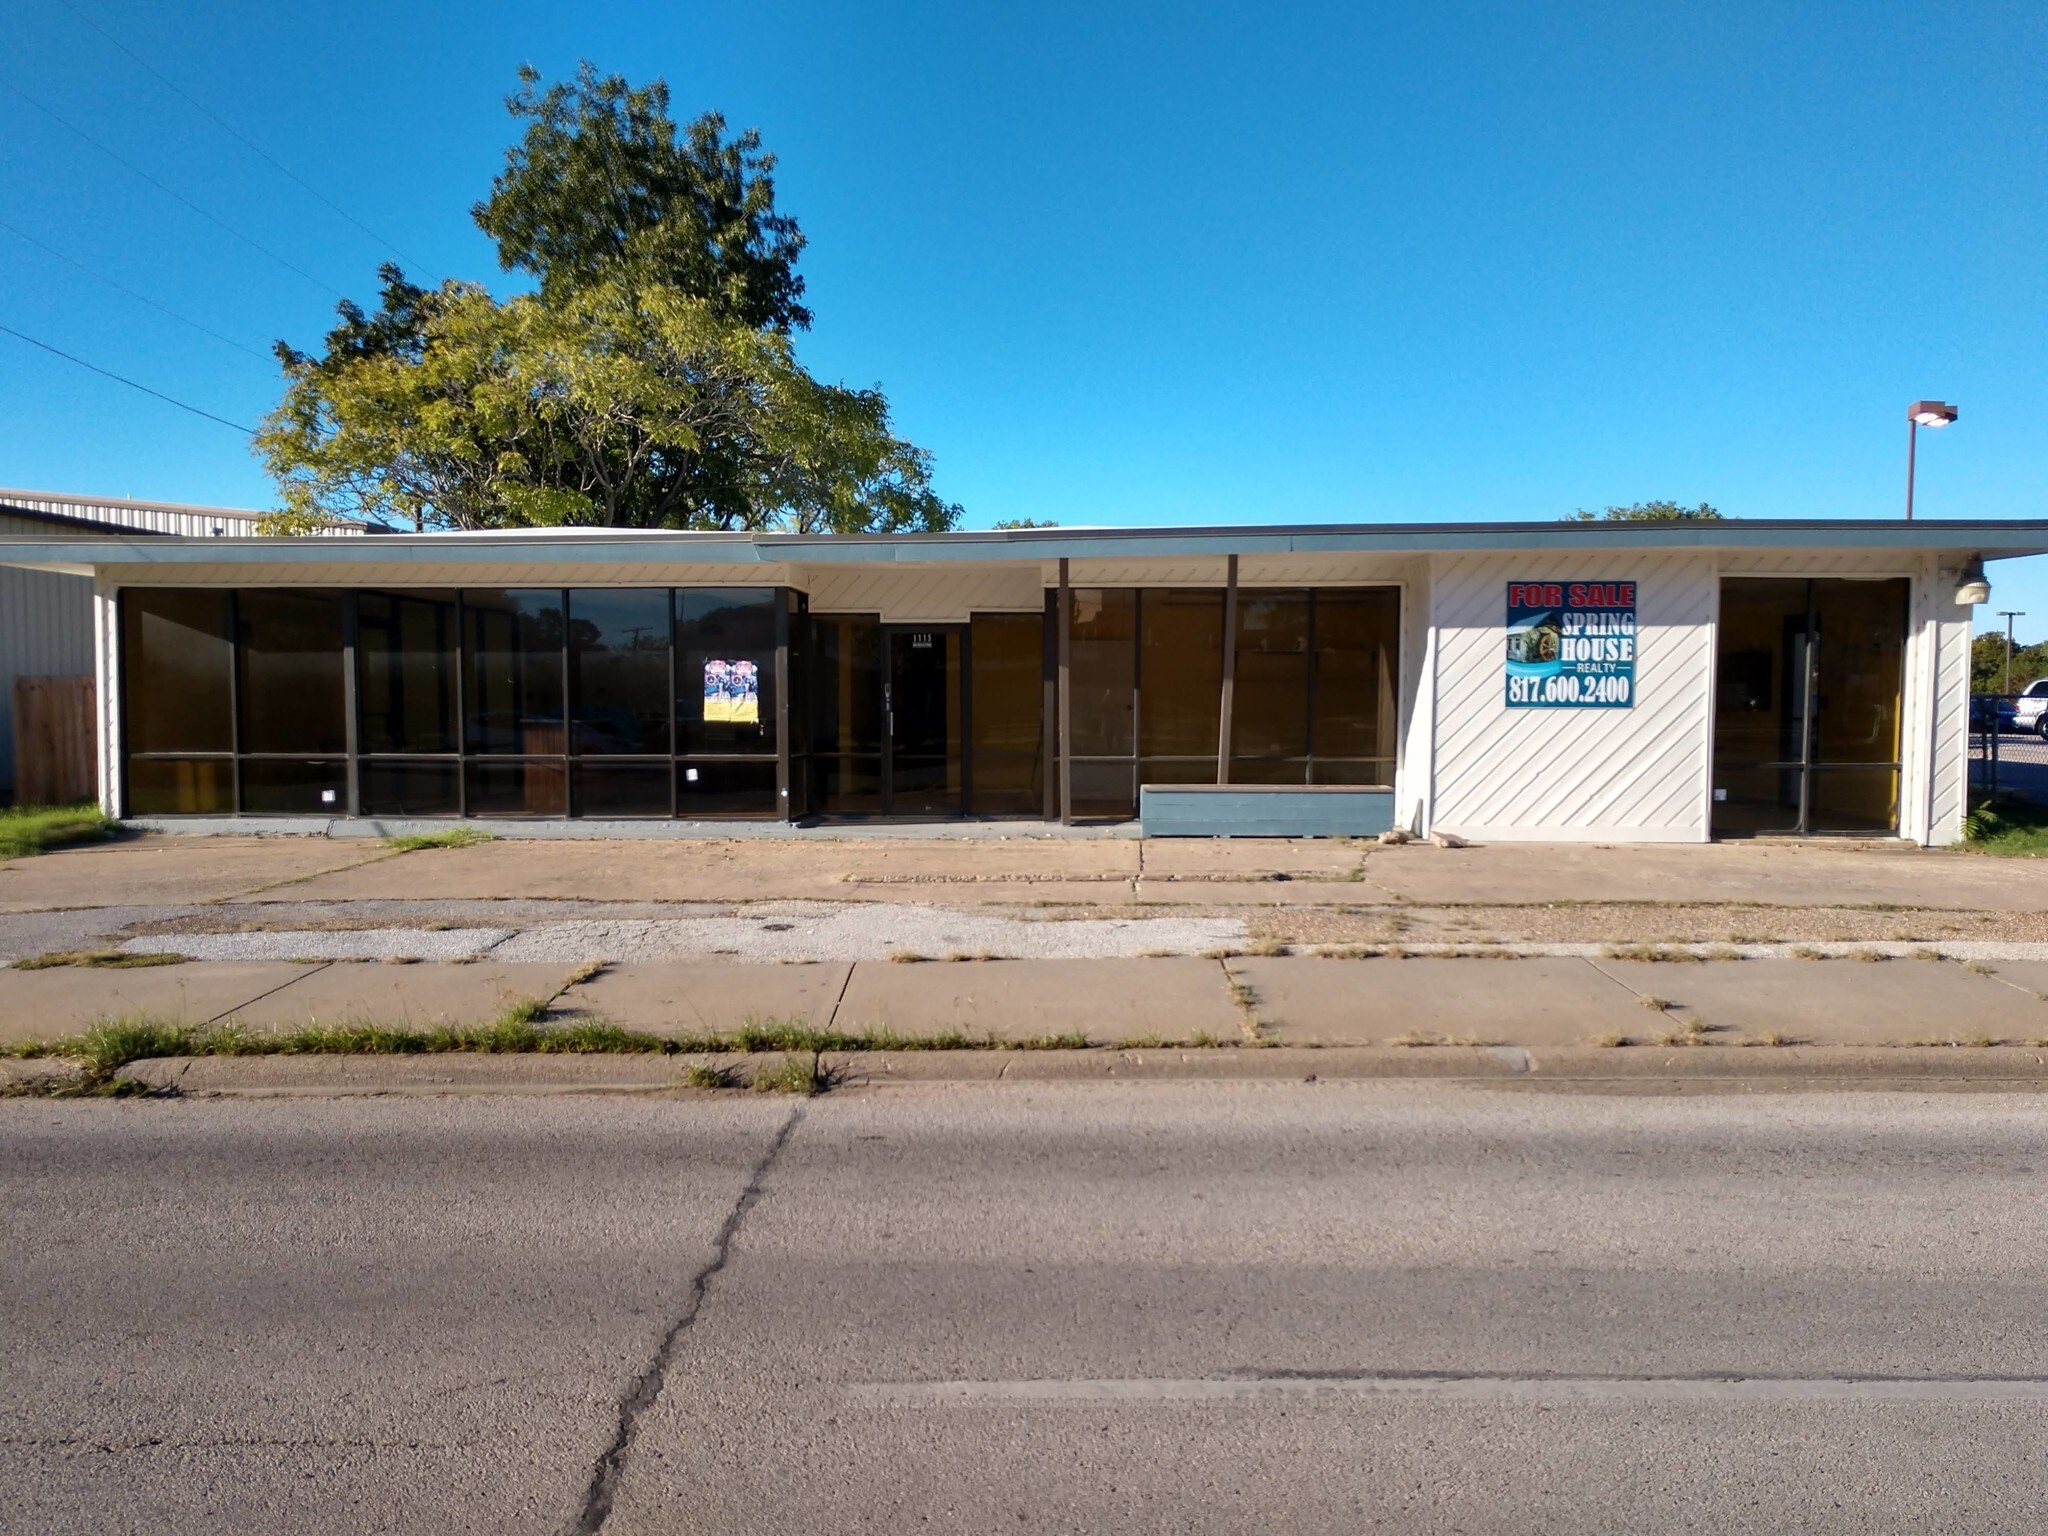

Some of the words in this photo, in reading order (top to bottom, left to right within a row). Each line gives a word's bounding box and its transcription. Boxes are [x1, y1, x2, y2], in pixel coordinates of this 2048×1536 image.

[1510, 584, 1562, 607] FOR
[1569, 584, 1634, 607] SALE
[1562, 612, 1634, 636] SPRING
[1561, 638, 1633, 661] HOUSE
[1577, 663, 1616, 673] REALTY
[1509, 676, 1629, 702] 817.600.2400
